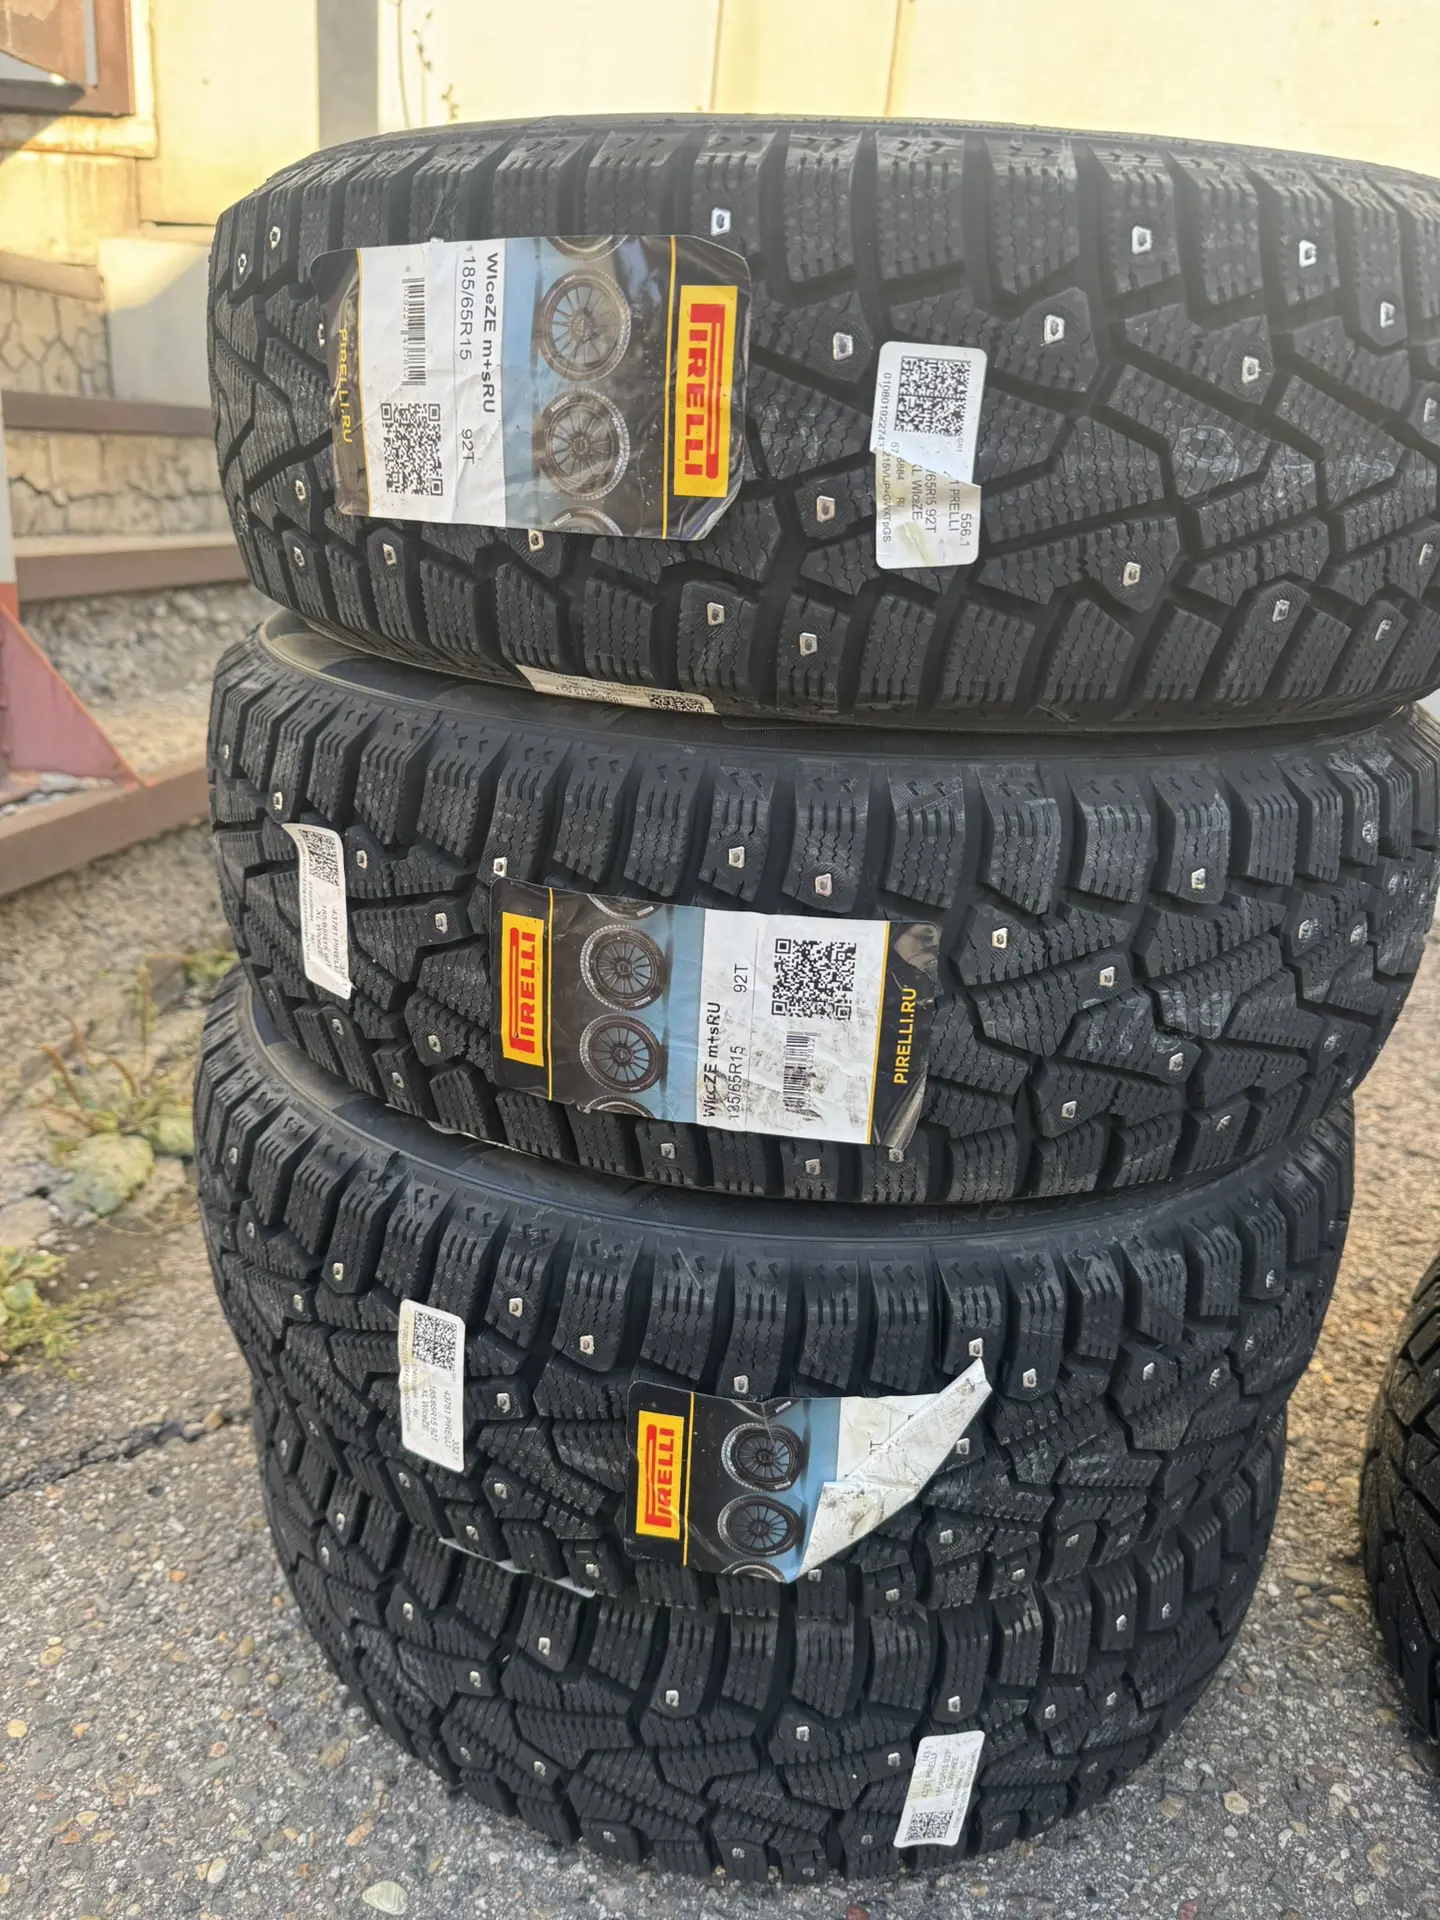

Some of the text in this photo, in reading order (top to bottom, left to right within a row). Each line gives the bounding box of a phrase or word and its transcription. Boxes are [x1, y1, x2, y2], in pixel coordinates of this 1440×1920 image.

[459, 256, 477, 464] 185/65R15 92T
[481, 252, 500, 413] WIceZE m+sRU
[337, 329, 353, 444] PIRELLI.RU
[684, 303, 726, 480] PIRELLI
[911, 480, 923, 520] WIceZE
[925, 509, 937, 533] 92T
[959, 513, 972, 547] 556.1
[509, 927, 536, 1054] PIRELLI
[734, 963, 749, 993] 92T
[704, 1001, 721, 1060] m+sRU
[894, 987, 918, 1085] PIRELLI.RU
[644, 1423, 675, 1529] PIRELLI
